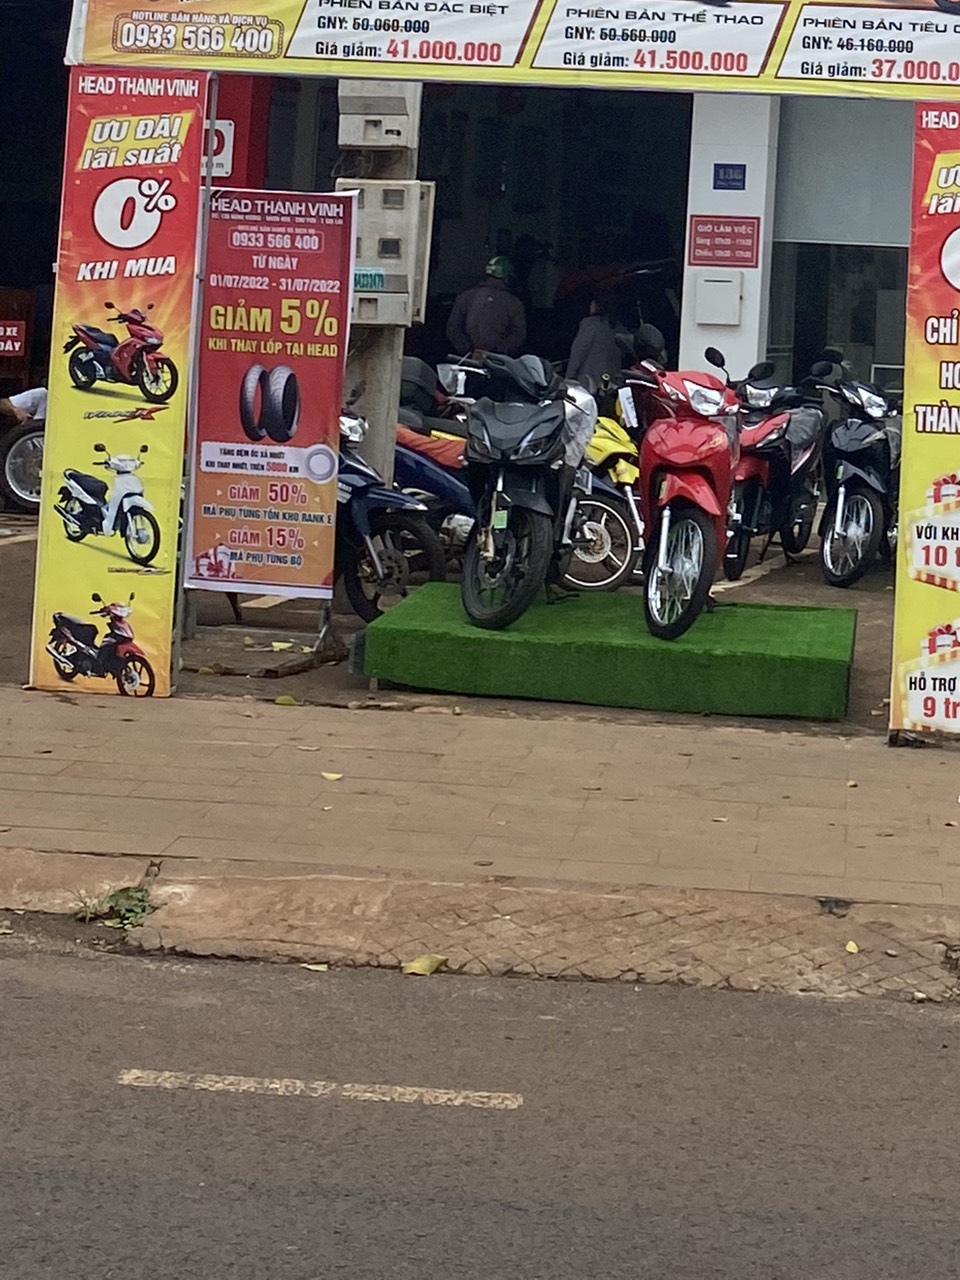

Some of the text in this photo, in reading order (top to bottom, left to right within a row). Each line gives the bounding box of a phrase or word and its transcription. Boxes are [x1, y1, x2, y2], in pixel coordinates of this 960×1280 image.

[132, 11, 169, 21] HOTLINE
[424, 1, 464, 16] ĐẶC
[469, 1, 509, 17] BIỆT
[566, 7, 764, 25] PHIÊN BẢN THỂ THAO
[317, 16, 348, 30] GNY:
[564, 26, 596, 40] GNY:
[802, 17, 857, 30] PHIÊN
[862, 18, 903, 31] BẢN
[908, 20, 948, 33] TIÊU
[121, 23, 273, 53] 0933 566 400
[802, 35, 832, 50] GNY:
[315, 39, 502, 62] Giá giảm: 41.000.000
[563, 48, 748, 72] Giá giảm: 41.500.000
[800, 61, 823, 76] Giá
[828, 61, 867, 77] giảm:
[78, 74, 199, 97] HEAD THÀNH VINH
[92, 113, 182, 143] ƯU ĐÃI
[921, 110, 959, 129] HEAD
[82, 139, 181, 169] lãi suất
[94, 177, 176, 249] 0%
[211, 197, 344, 217] HEAD THÀNH VINH
[232, 231, 319, 250] 0933 566 400
[77, 256, 176, 281] KHI MUA
[268, 255, 299, 270] NGÀY
[210, 274, 269, 290] 01/07/2022
[279, 278, 341, 294] 31/07/2022
[210, 298, 339, 337] GIẢM 5%
[925, 309, 958, 345] CHỈ
[208, 337, 338, 357] KHI THAY TẠI HEAD
[229, 482, 308, 504] GIẢM 50%
[282, 511, 300, 522] KHO
[229, 526, 305, 548] GIẢM 15%
[916, 523, 937, 540] VỚI
[921, 545, 948, 567] 10
[931, 676, 957, 695] TRỢ
[923, 696, 936, 718] 9
